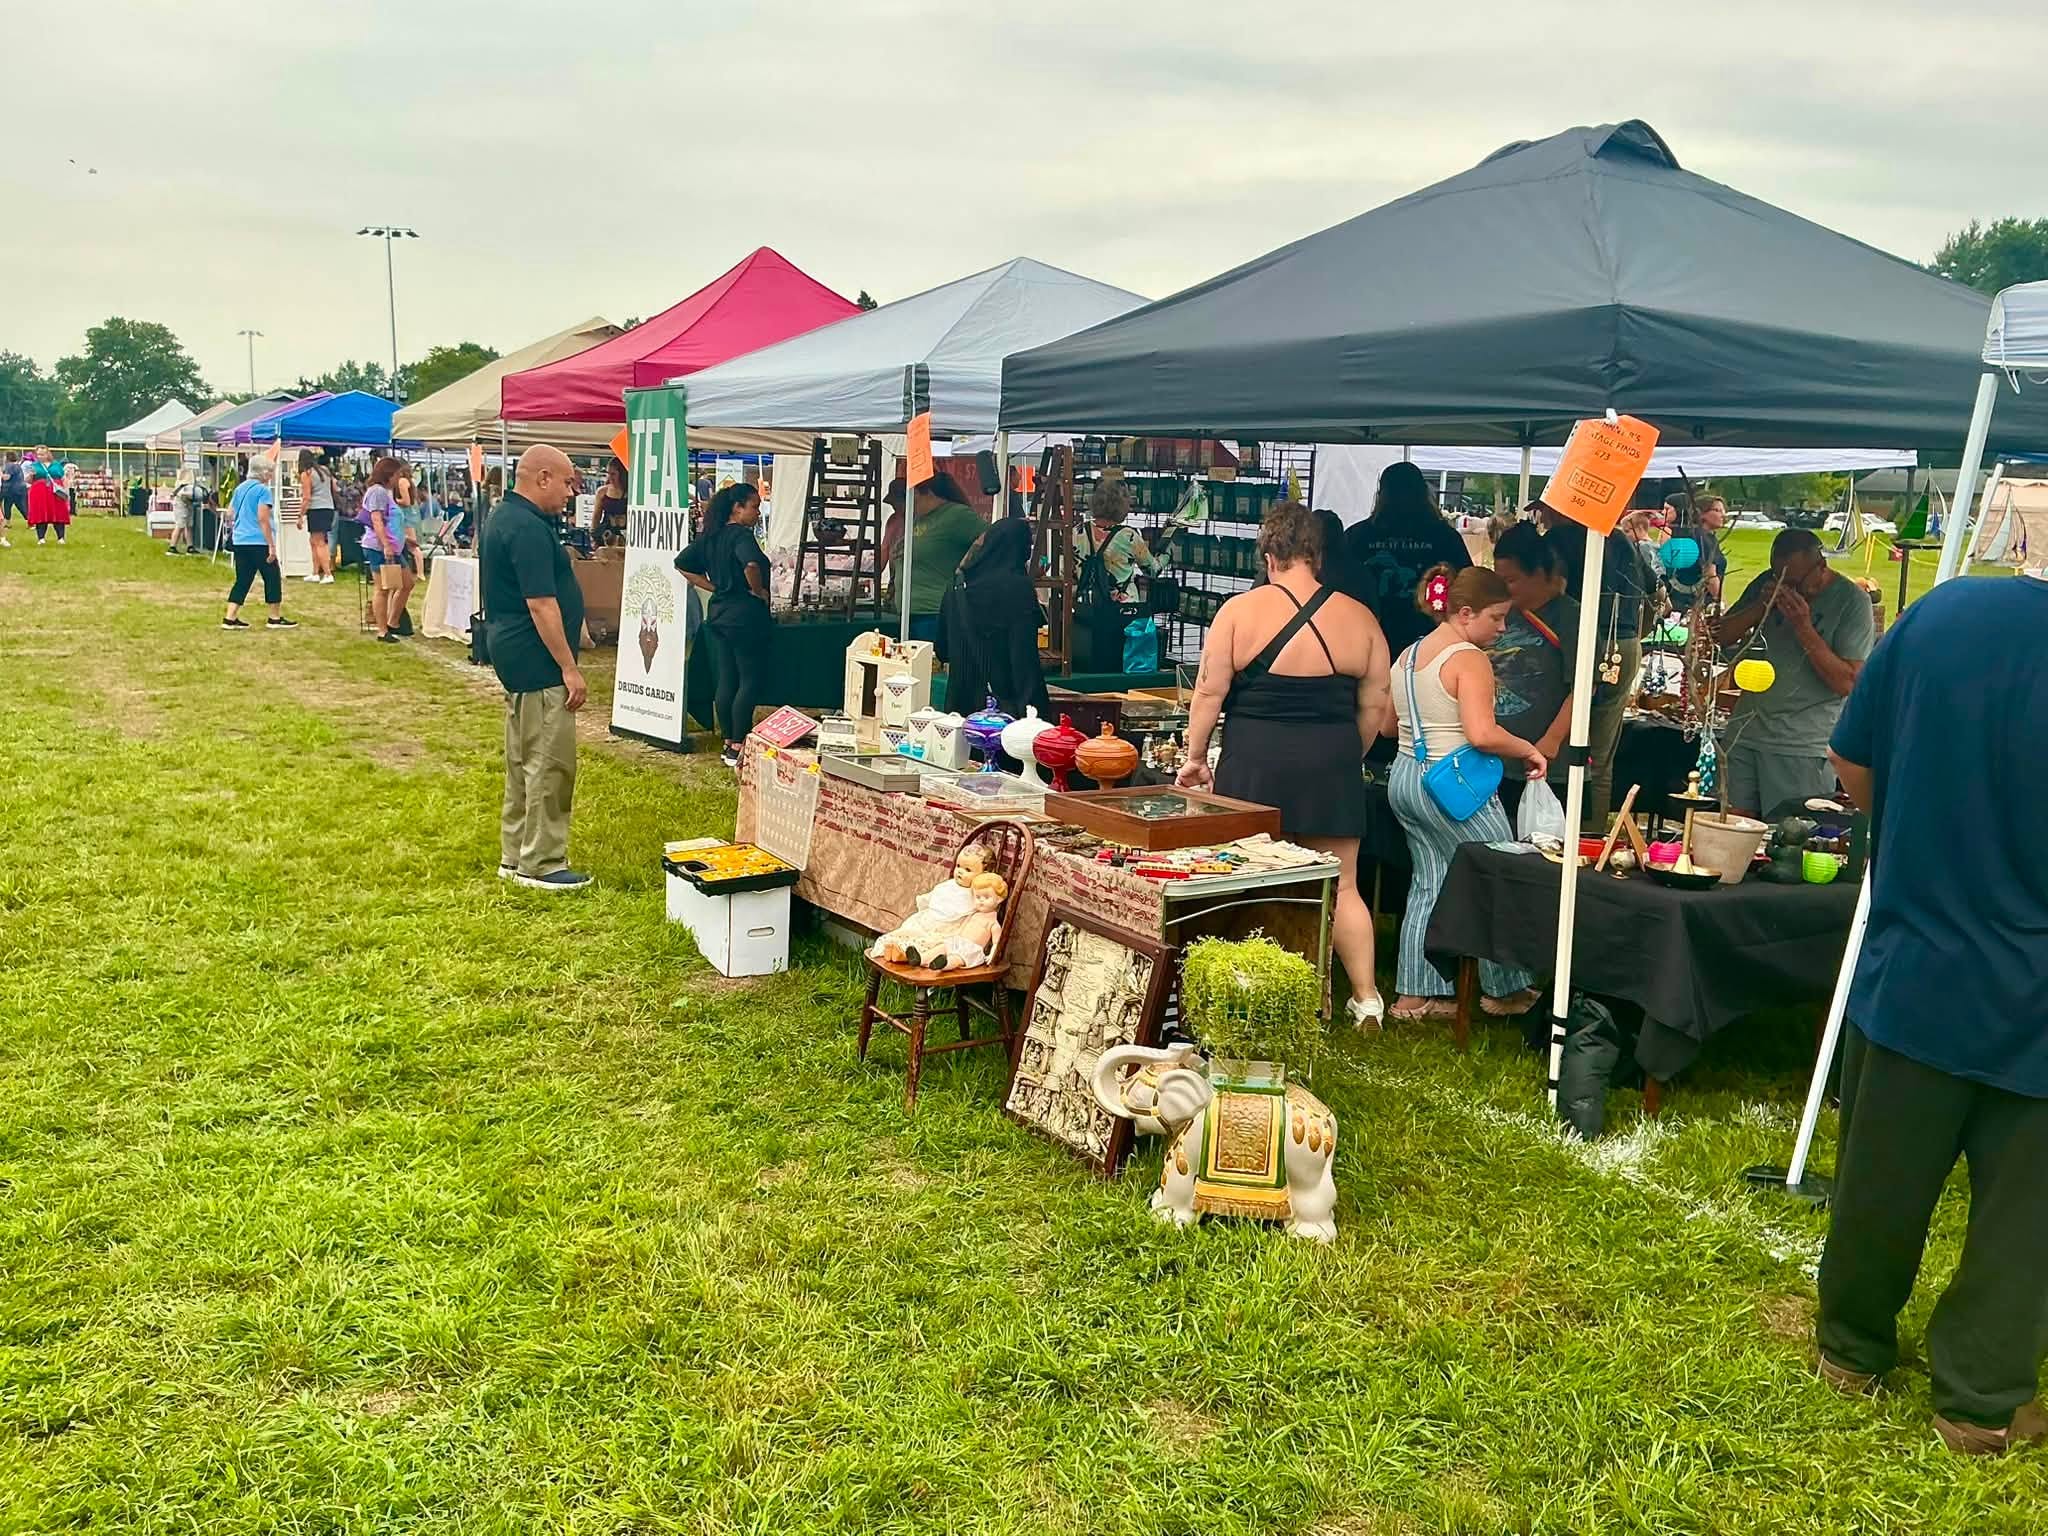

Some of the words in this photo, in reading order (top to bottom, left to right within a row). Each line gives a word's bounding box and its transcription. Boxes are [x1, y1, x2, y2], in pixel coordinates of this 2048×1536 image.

[631, 418, 680, 508] TEA
[1616, 442, 1641, 459] FINDS
[1572, 472, 1609, 498] RAFFLE
[626, 510, 685, 552] OMPANY
[618, 680, 644, 695] DRUIDS
[645, 686, 675, 702] GARDEN
